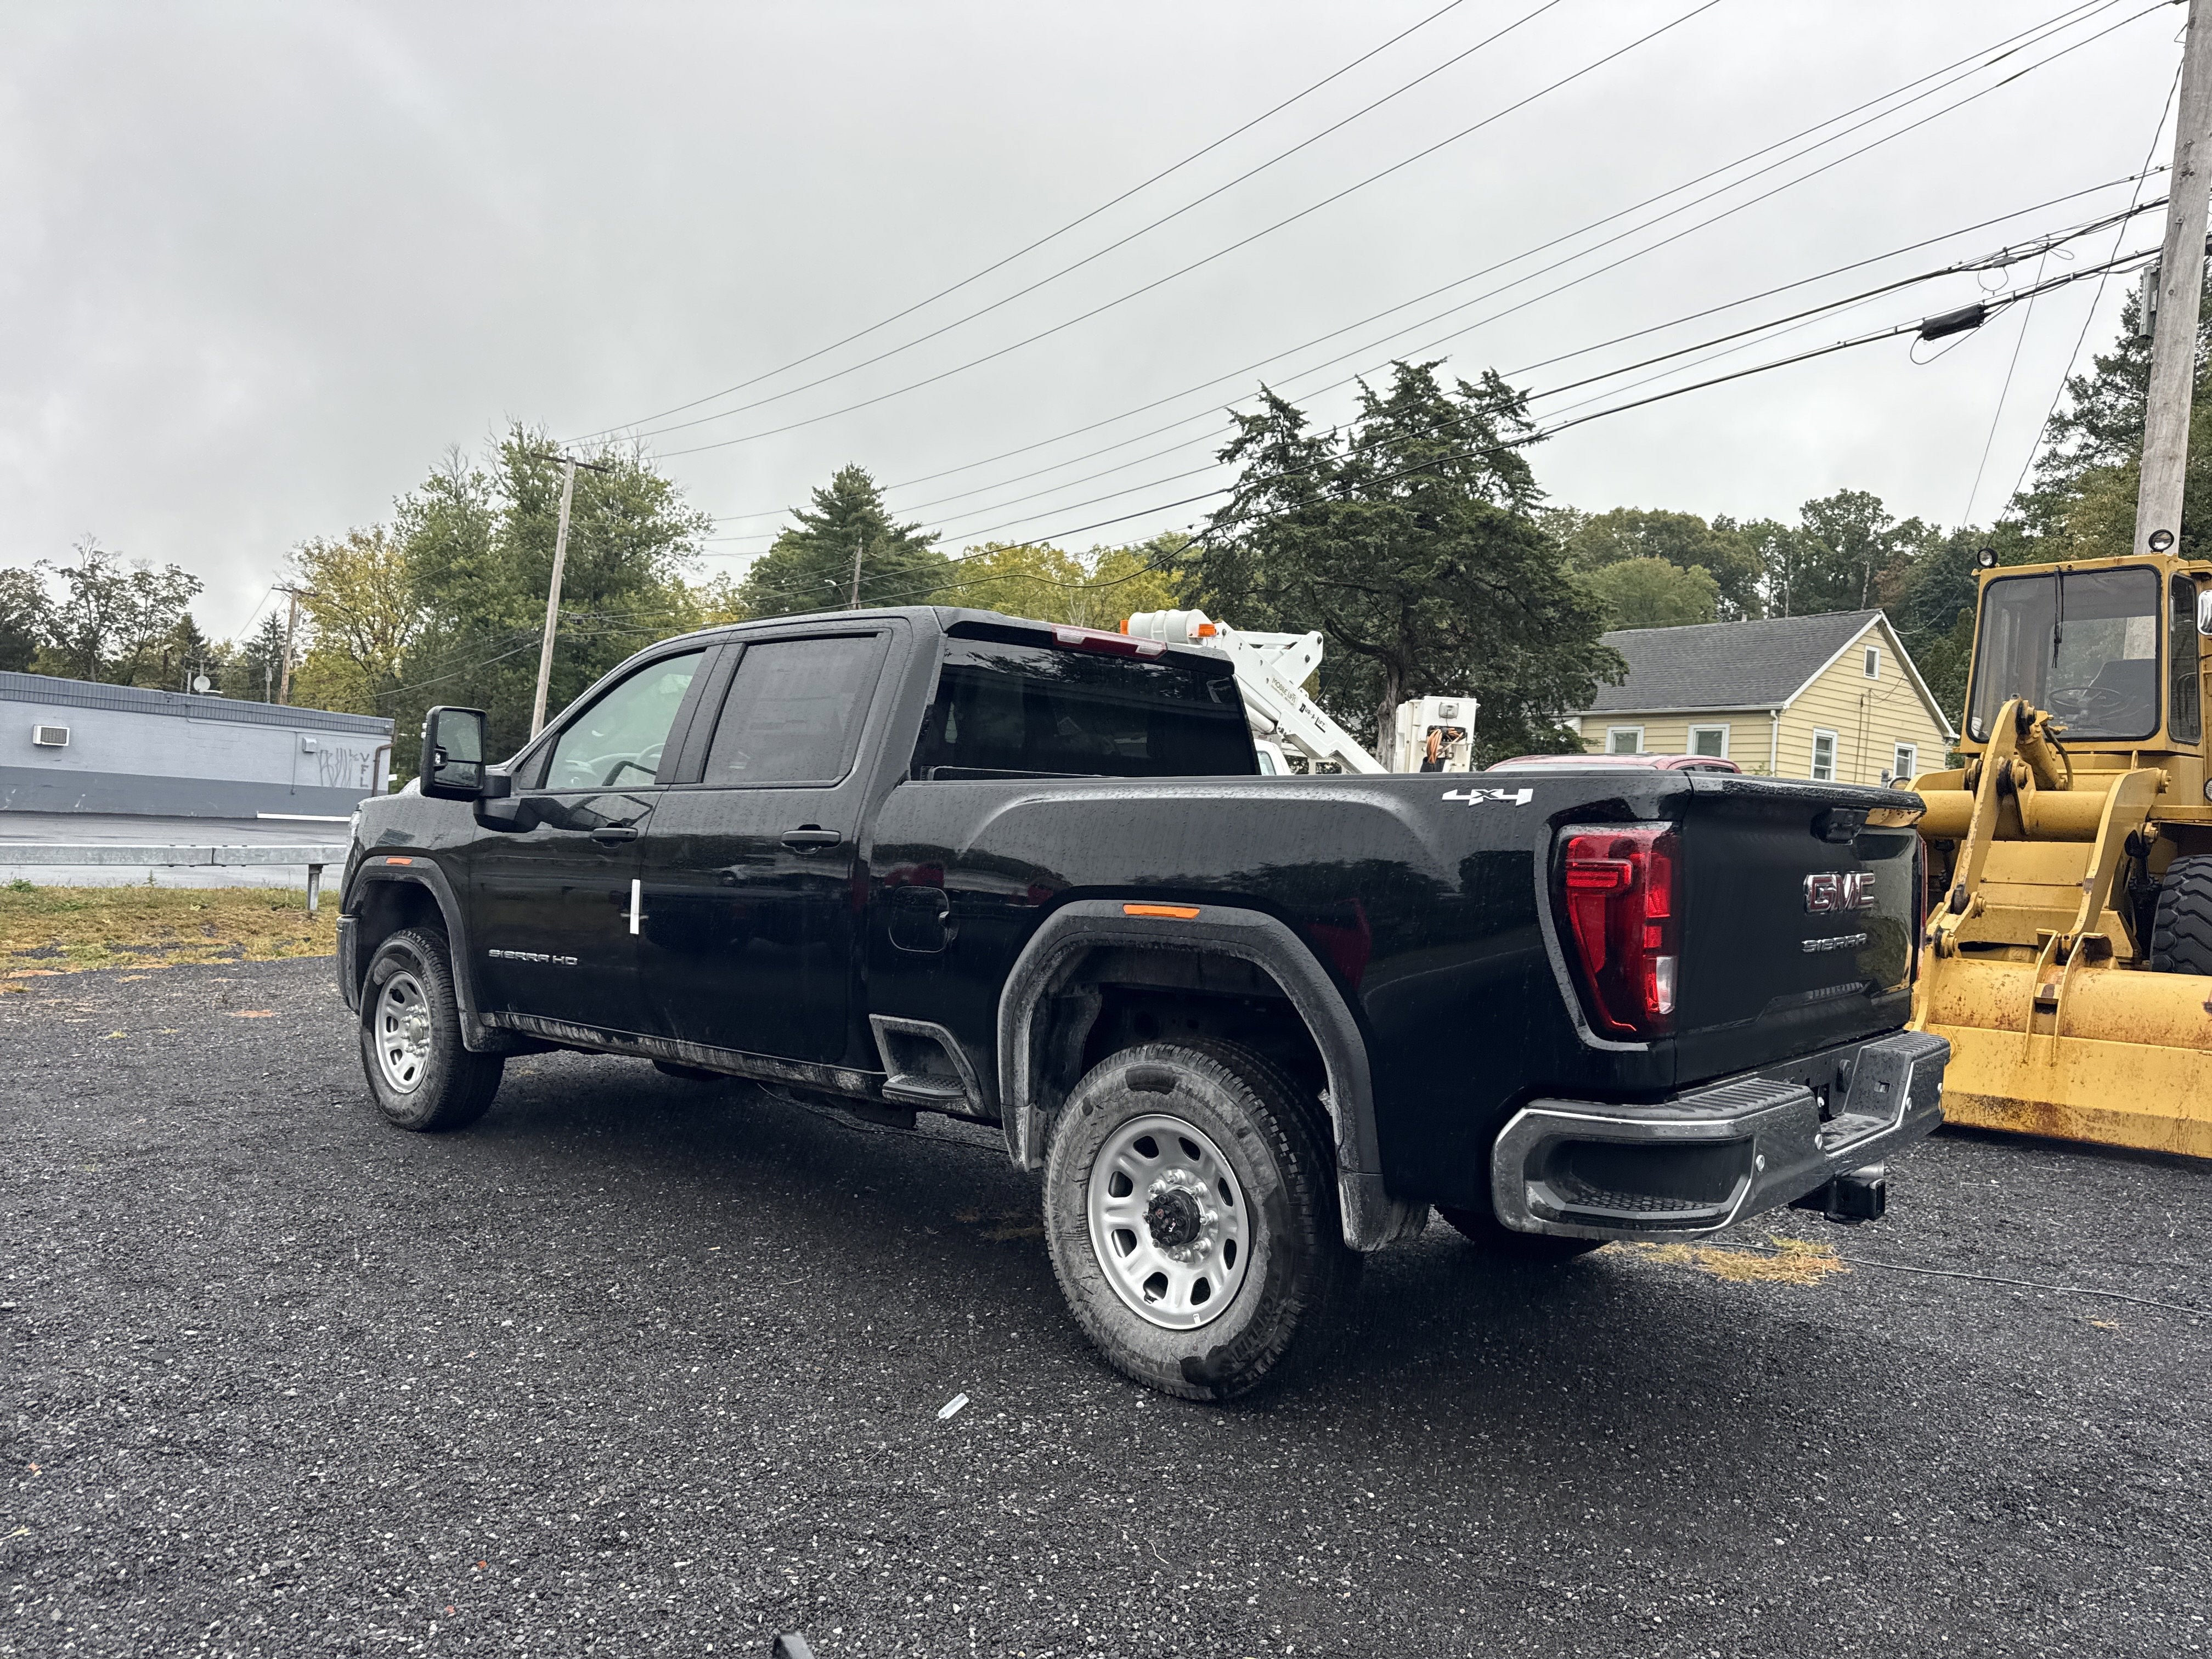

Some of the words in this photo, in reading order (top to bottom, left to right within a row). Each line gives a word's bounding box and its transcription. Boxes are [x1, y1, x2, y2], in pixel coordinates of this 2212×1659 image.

[1272, 678, 1288, 696] MOBILE
[1288, 691, 1296, 703] LIFTS
[1803, 871, 1875, 913] GMC
[1802, 933, 1867, 953] SIERRA
[488, 949, 549, 963] SIERRA
[552, 955, 578, 966] HD
